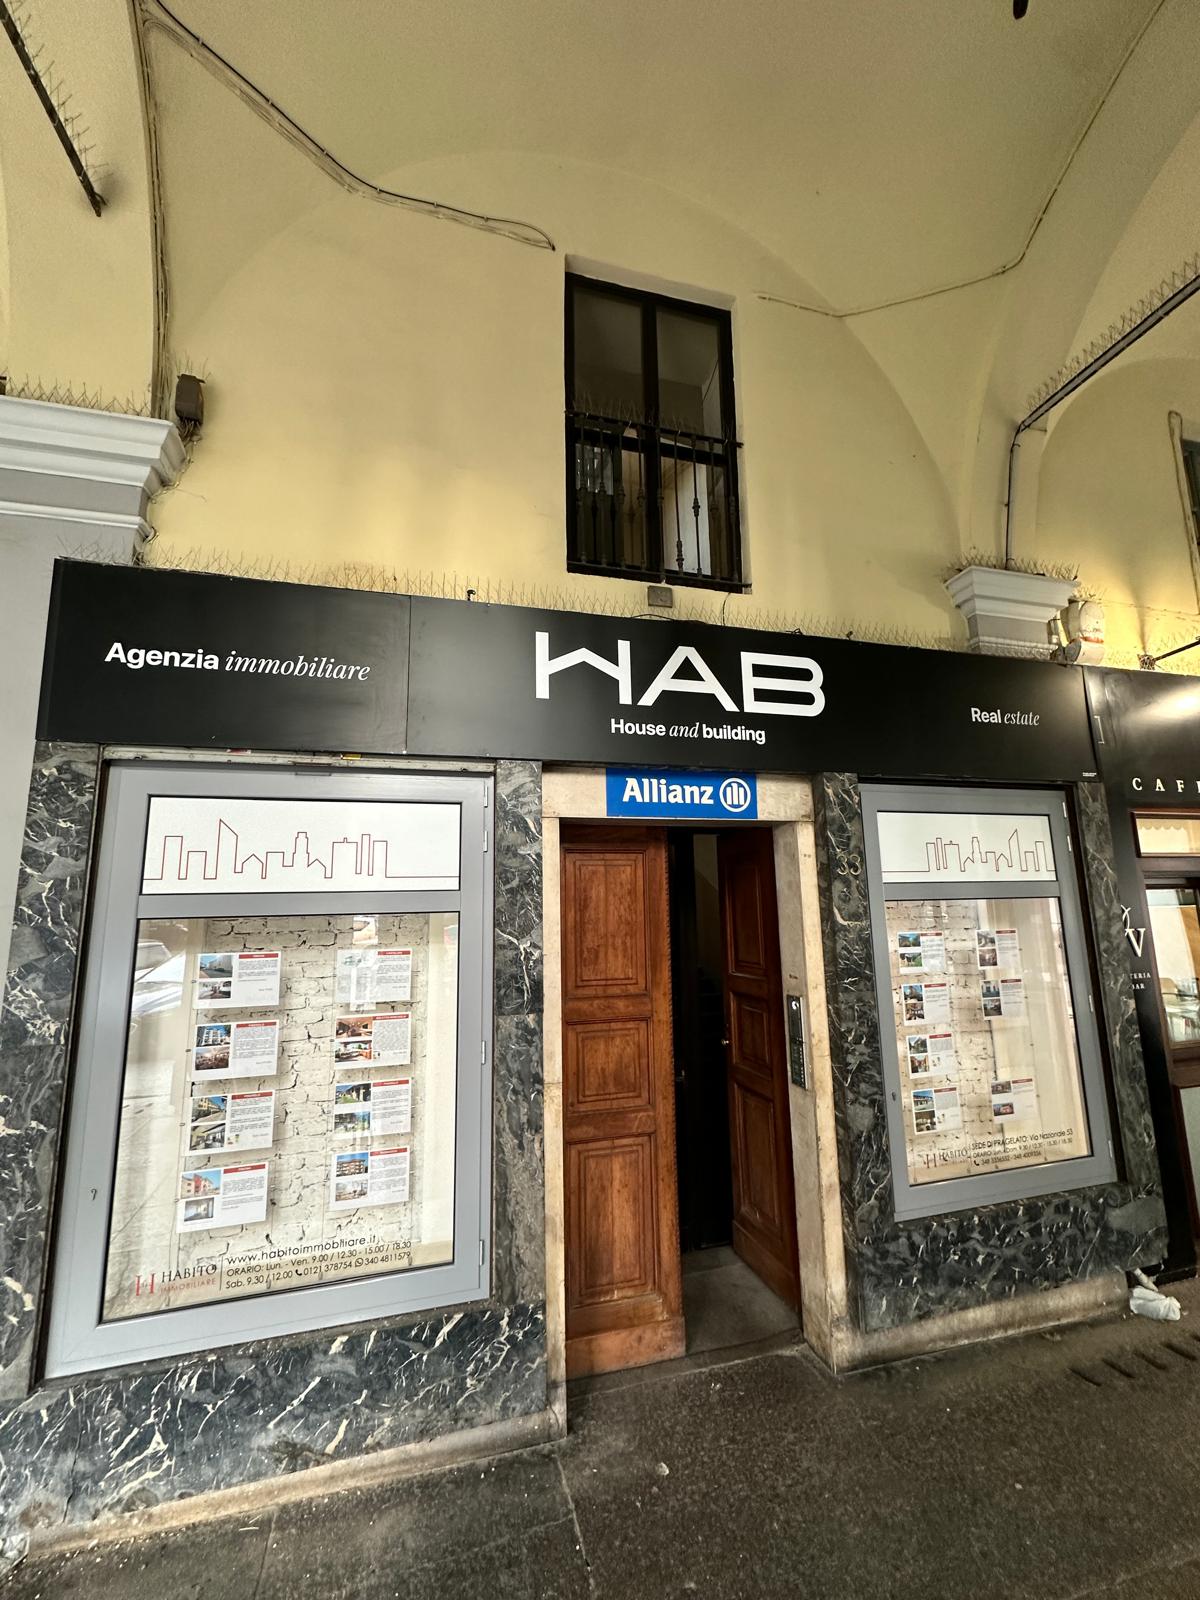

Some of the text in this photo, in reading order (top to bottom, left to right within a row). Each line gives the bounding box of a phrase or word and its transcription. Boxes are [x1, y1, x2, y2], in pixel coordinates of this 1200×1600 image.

[104, 642, 371, 681] Agenzia immobiliare
[535, 631, 826, 717] HAB
[970, 707, 1040, 726] Real estate
[610, 718, 766, 745] House and building
[622, 777, 714, 805] Allianz
[1132, 777, 1200, 793] CAF
[836, 853, 861, 876] 33
[972, 1141, 986, 1151] SEDE
[1030, 1133, 1039, 1141] Via
[225, 1235, 376, 1264] www.habitoimmobiliare.it
[227, 1264, 264, 1277] ORARIO:
[266, 1262, 281, 1271] Lun.
[291, 1259, 310, 1267] Ven.
[312, 1254, 329, 1264] 9.00
[337, 1249, 357, 1259] 12.30
[365, 1245, 385, 1255] 15.00
[392, 1241, 412, 1250] 18.30
[162, 1264, 217, 1283] HABITO
[226, 1280, 245, 1290] Sab.
[247, 1275, 265, 1285] 9.30
[272, 1270, 293, 1281] 12.00
[303, 1266, 322, 1276] 0121
[324, 1261, 353, 1272] 378754
[365, 1257, 379, 1265] 340
[380, 1251, 411, 1262] 4811579
[160, 1278, 217, 1292] IMMOBILIARE
